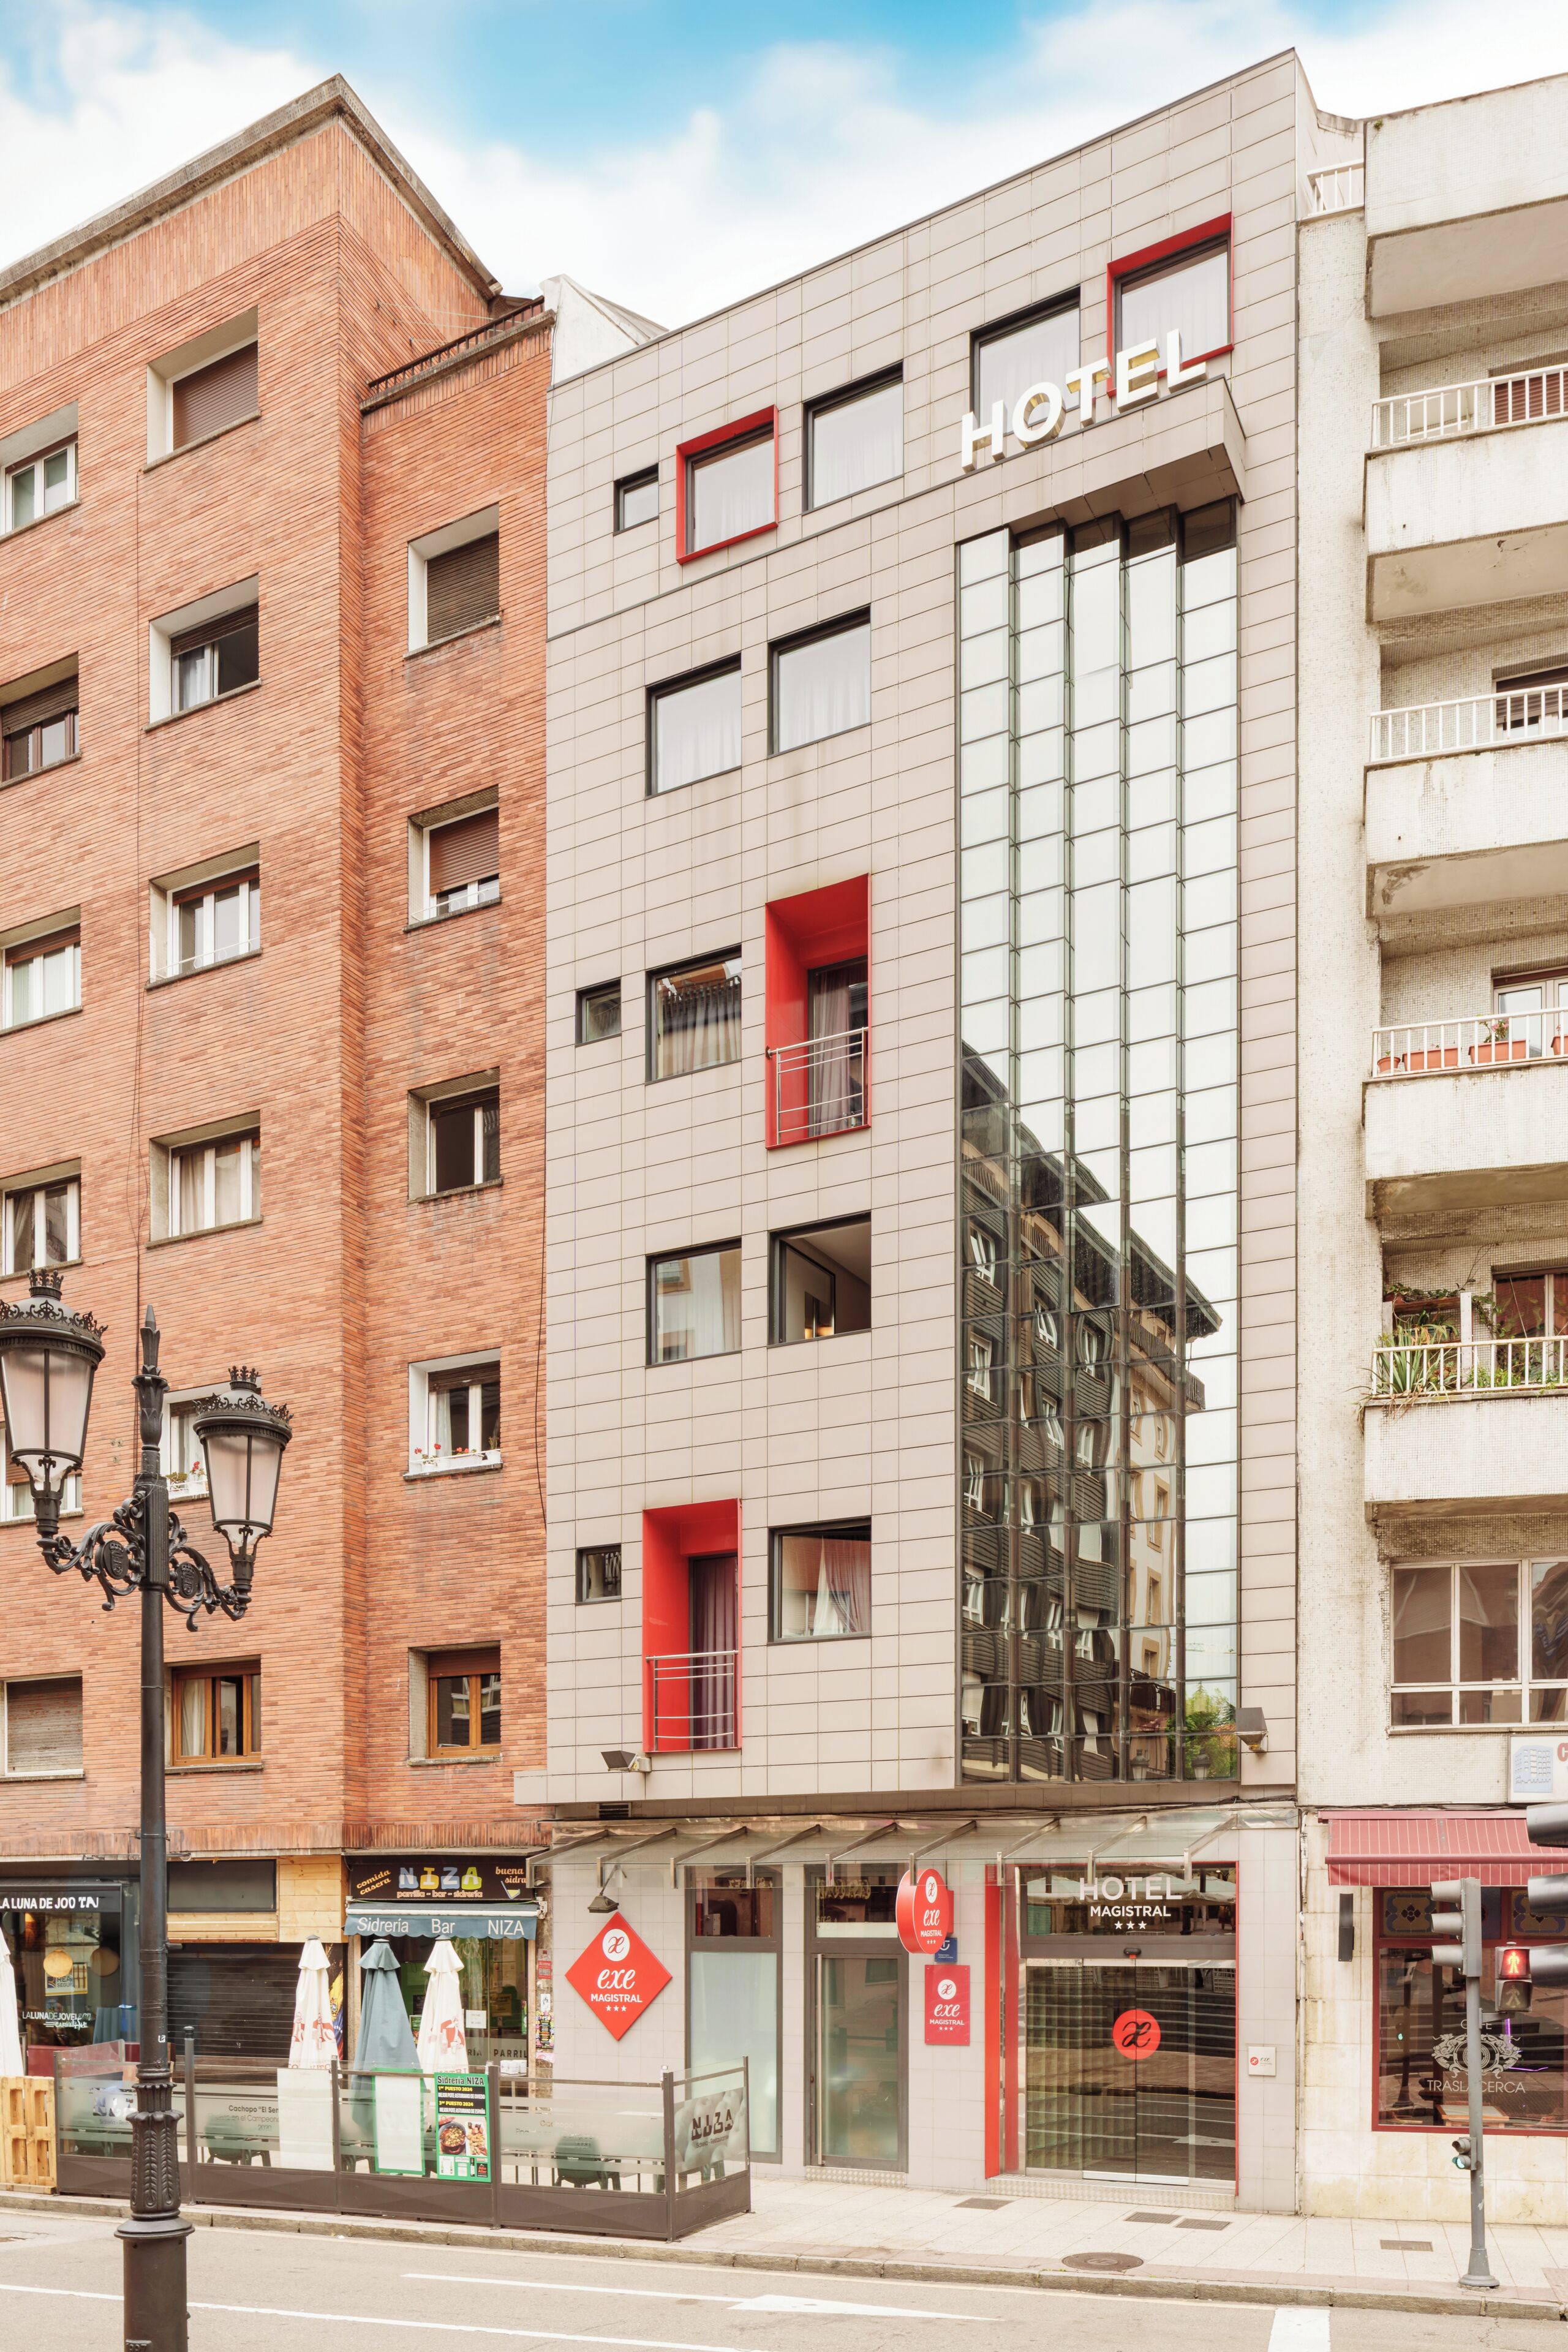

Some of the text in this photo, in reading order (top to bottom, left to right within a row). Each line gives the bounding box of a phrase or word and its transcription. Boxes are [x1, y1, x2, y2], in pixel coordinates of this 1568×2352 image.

[962, 329, 1207, 472] HOTEL
[356, 1870, 391, 1888] comida
[399, 1867, 482, 1890] NIZA
[496, 1866, 524, 1875] buena
[360, 1878, 391, 1895] casera
[1079, 1877, 1182, 1901] HOTEL
[12, 1898, 37, 1909] LUNA
[39, 1898, 53, 1909] DE
[1090, 1906, 1171, 1917] MAGISTRAL
[924, 1909, 940, 1926] exe
[357, 1917, 524, 1936] Sidrería Bar NIZA
[597, 1969, 636, 1989] exe
[590, 1994, 643, 2003] MAGISTRAL
[934, 2004, 960, 2017] exe
[494, 2049, 528, 2058] PARRIL
[1427, 2080, 1526, 2094] TRASLCERCA
[691, 2109, 734, 2141] NIZA
